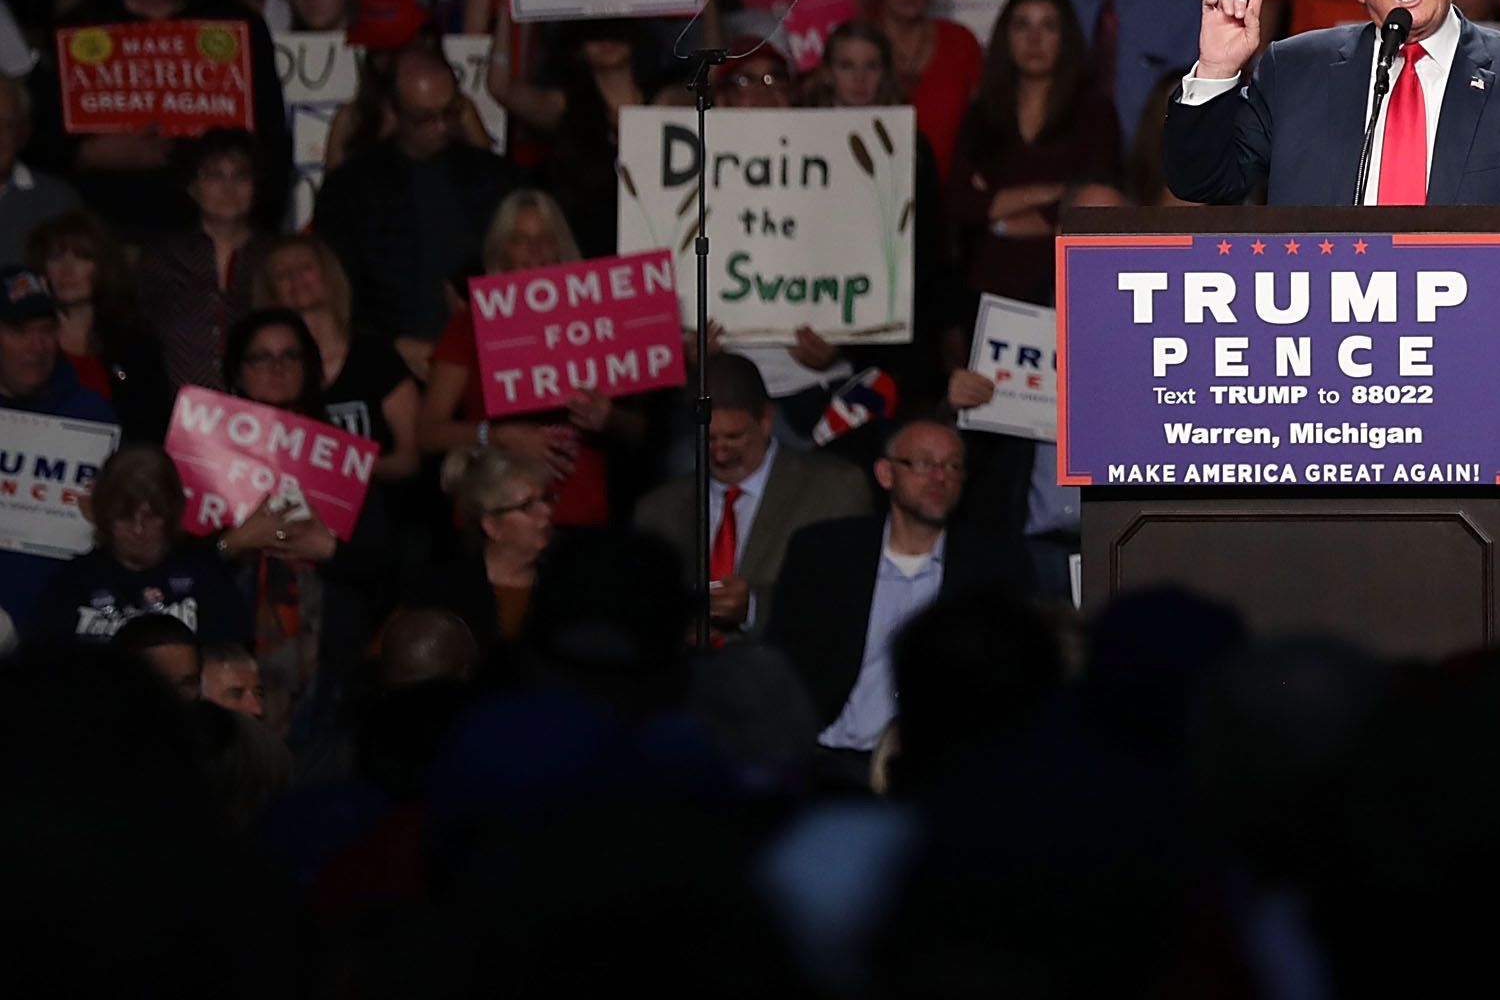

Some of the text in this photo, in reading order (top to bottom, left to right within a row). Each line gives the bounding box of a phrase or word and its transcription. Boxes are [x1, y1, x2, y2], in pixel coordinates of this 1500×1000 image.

[121, 36, 187, 56] MAKE
[70, 59, 245, 92] AMERICA
[80, 89, 237, 116] GREAT AGAIN
[662, 124, 831, 189] Drain
[742, 208, 797, 237] the
[473, 260, 674, 321] WOMEN
[722, 253, 870, 325] Swamp
[1117, 270, 1469, 325] TRUMP
[543, 316, 616, 350] FOR
[1152, 334, 1434, 378] PENCE
[493, 343, 674, 404] TRUMP
[1153, 385, 1434, 406] Text TRUMP to 88022
[178, 399, 377, 484] WOMEN
[1164, 421, 1423, 450] Warren, Michigan
[0, 451, 98, 484] UMP
[226, 458, 302, 504] FOR
[1108, 463, 1482, 482] MAKE AMERICA GREAT AGAIN!
[0, 479, 78, 505] NCE
